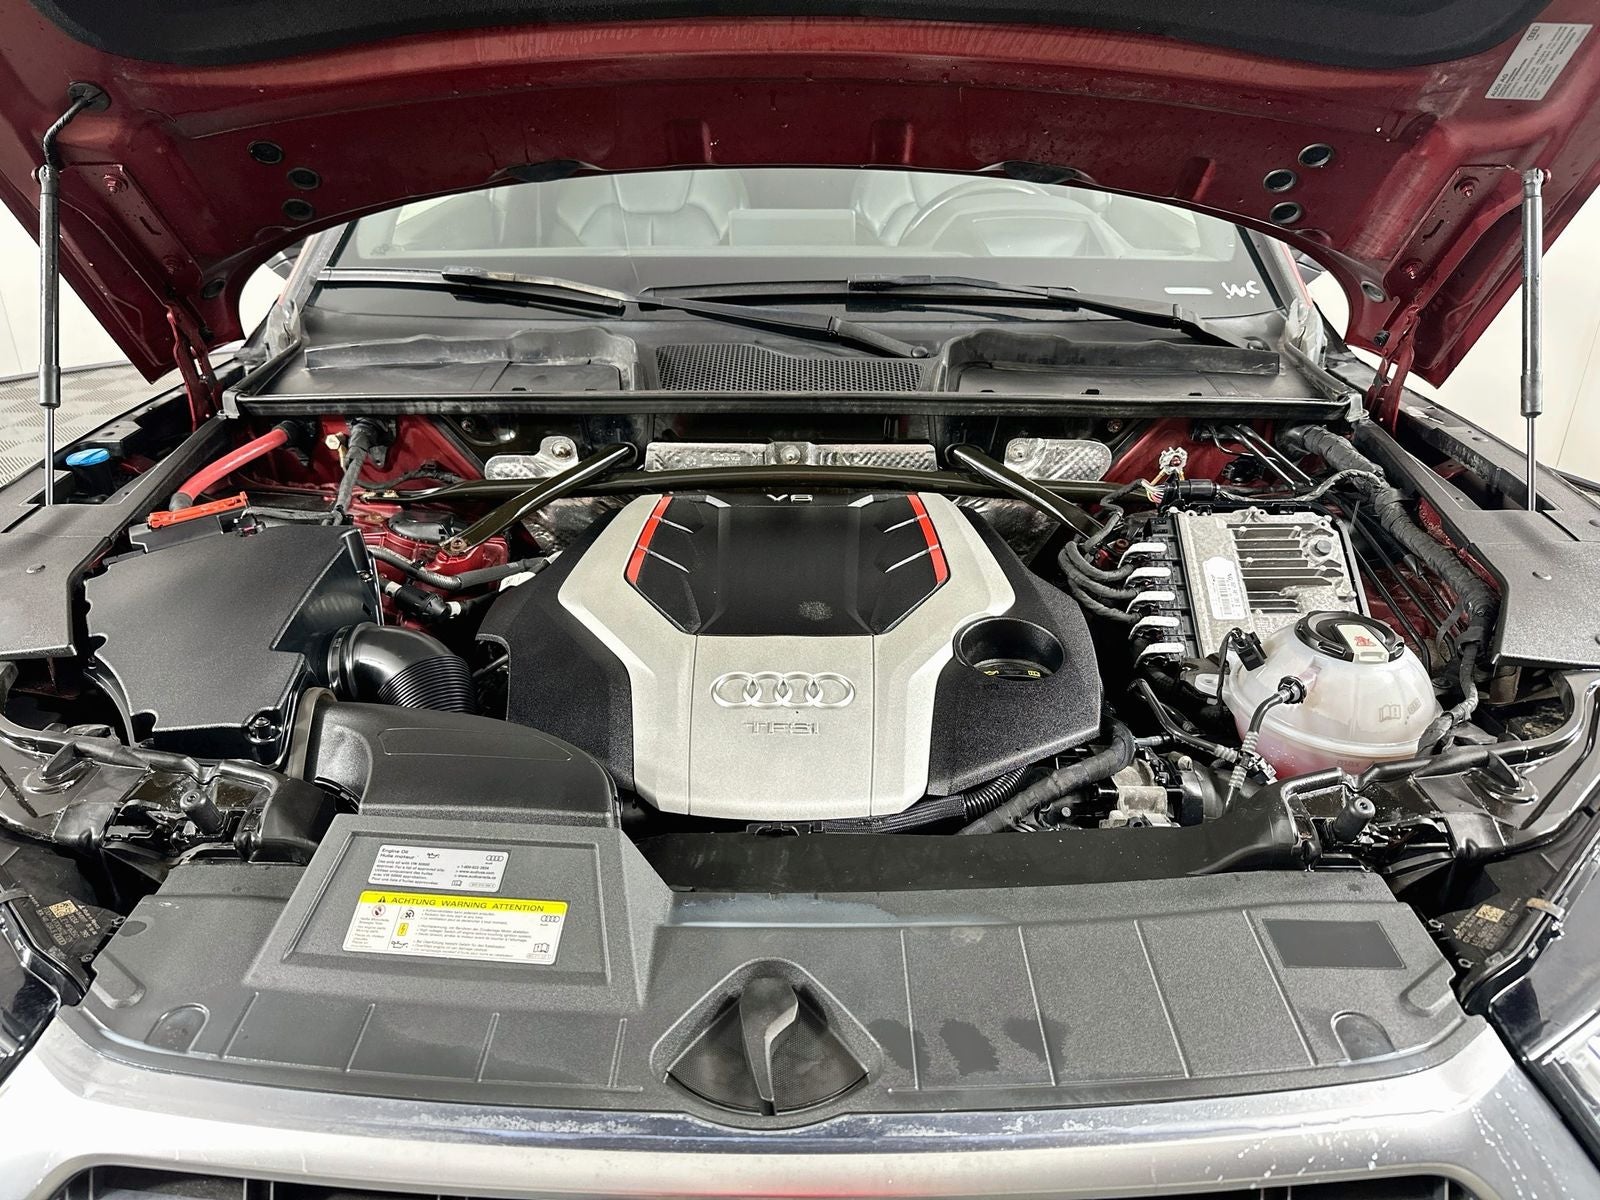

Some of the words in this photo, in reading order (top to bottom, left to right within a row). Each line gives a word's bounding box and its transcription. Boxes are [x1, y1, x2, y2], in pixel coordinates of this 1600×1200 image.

[743, 721, 820, 735] TFSI
[390, 897, 436, 906] ACHTUNG
[441, 900, 487, 909] WARNING
[491, 903, 544, 912] ATTENTION
